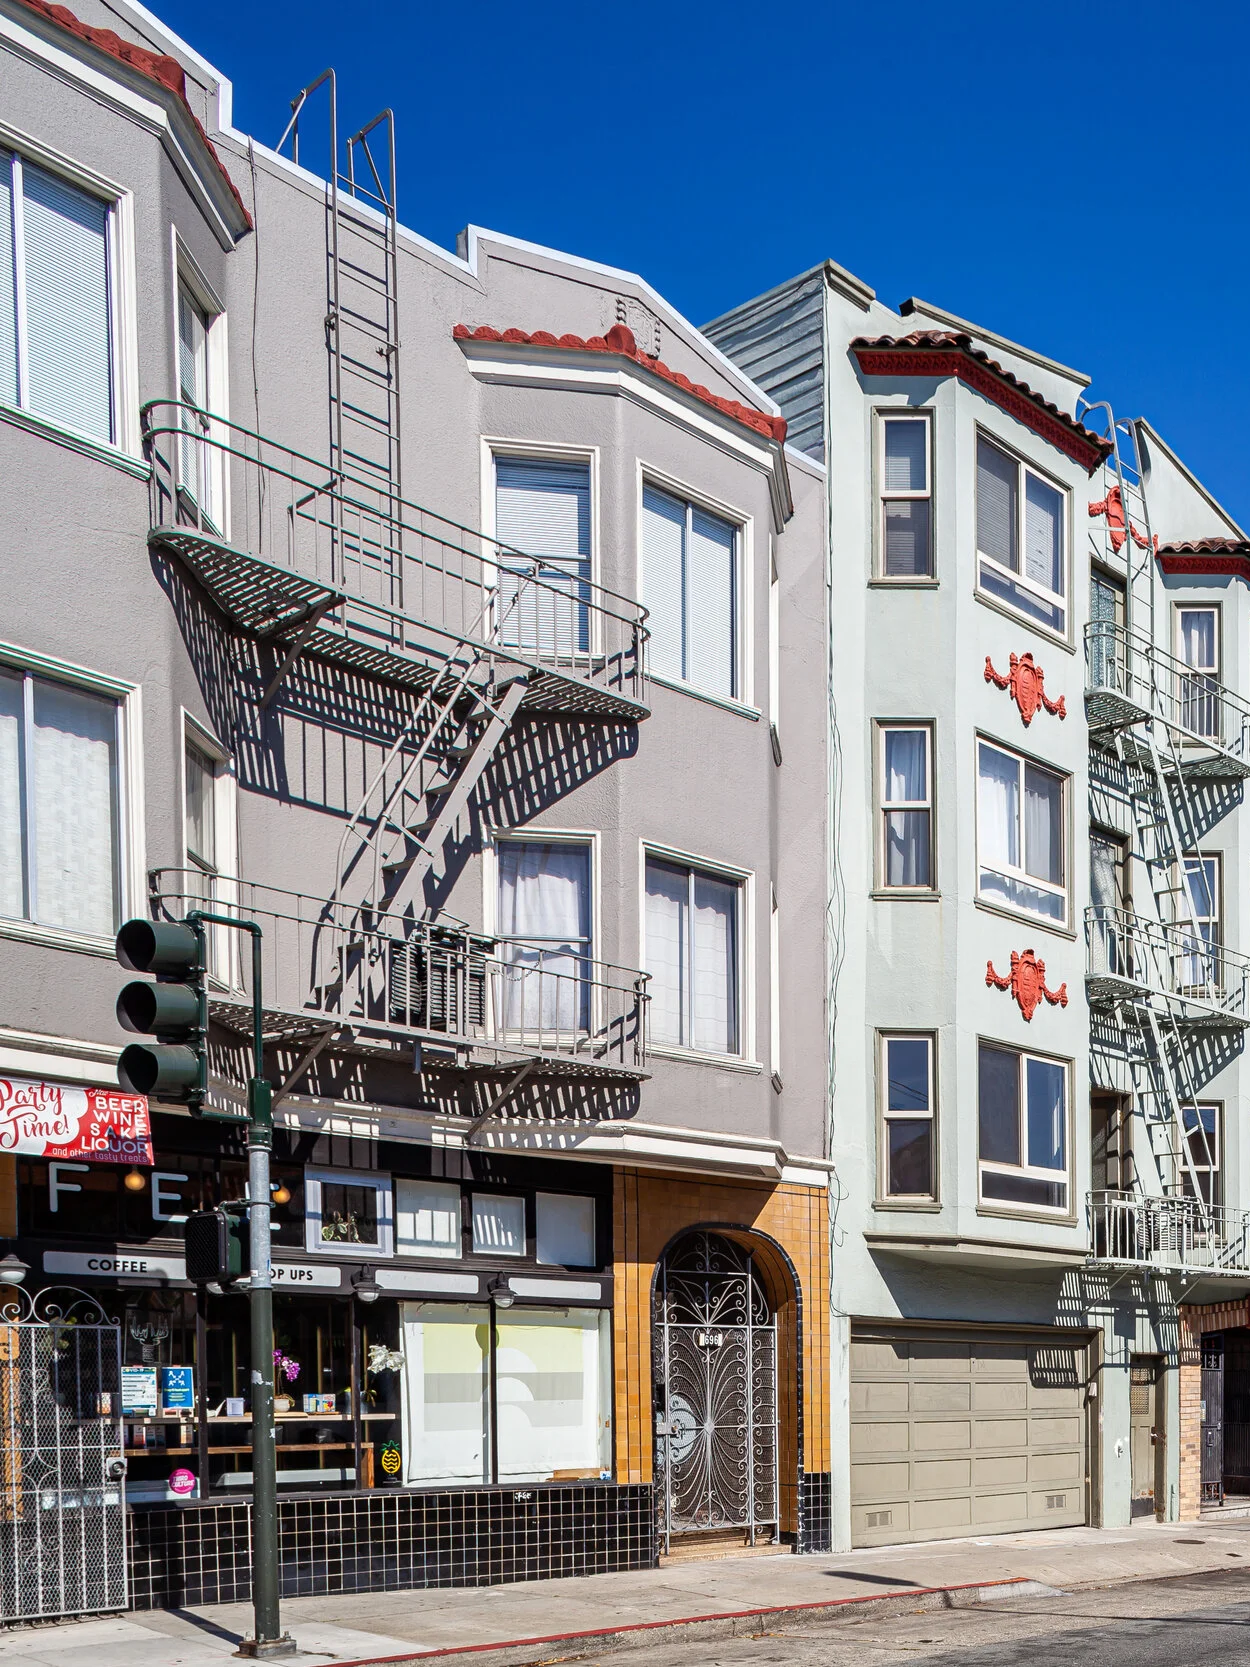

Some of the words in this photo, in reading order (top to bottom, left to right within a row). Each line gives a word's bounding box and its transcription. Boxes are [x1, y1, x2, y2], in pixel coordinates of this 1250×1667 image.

[96, 1097, 144, 1113] BEER
[93, 1110, 147, 1128] WINE
[0, 1113, 70, 1149] Time!
[90, 1122, 147, 1141] SAKE
[81, 1136, 147, 1154] LIQUOR
[52, 1147, 68, 1157] and
[70, 1149, 91, 1159] other
[95, 1151, 118, 1163] tasty
[88, 1258, 147, 1273] COFFEE
[290, 1269, 313, 1281] UPS
